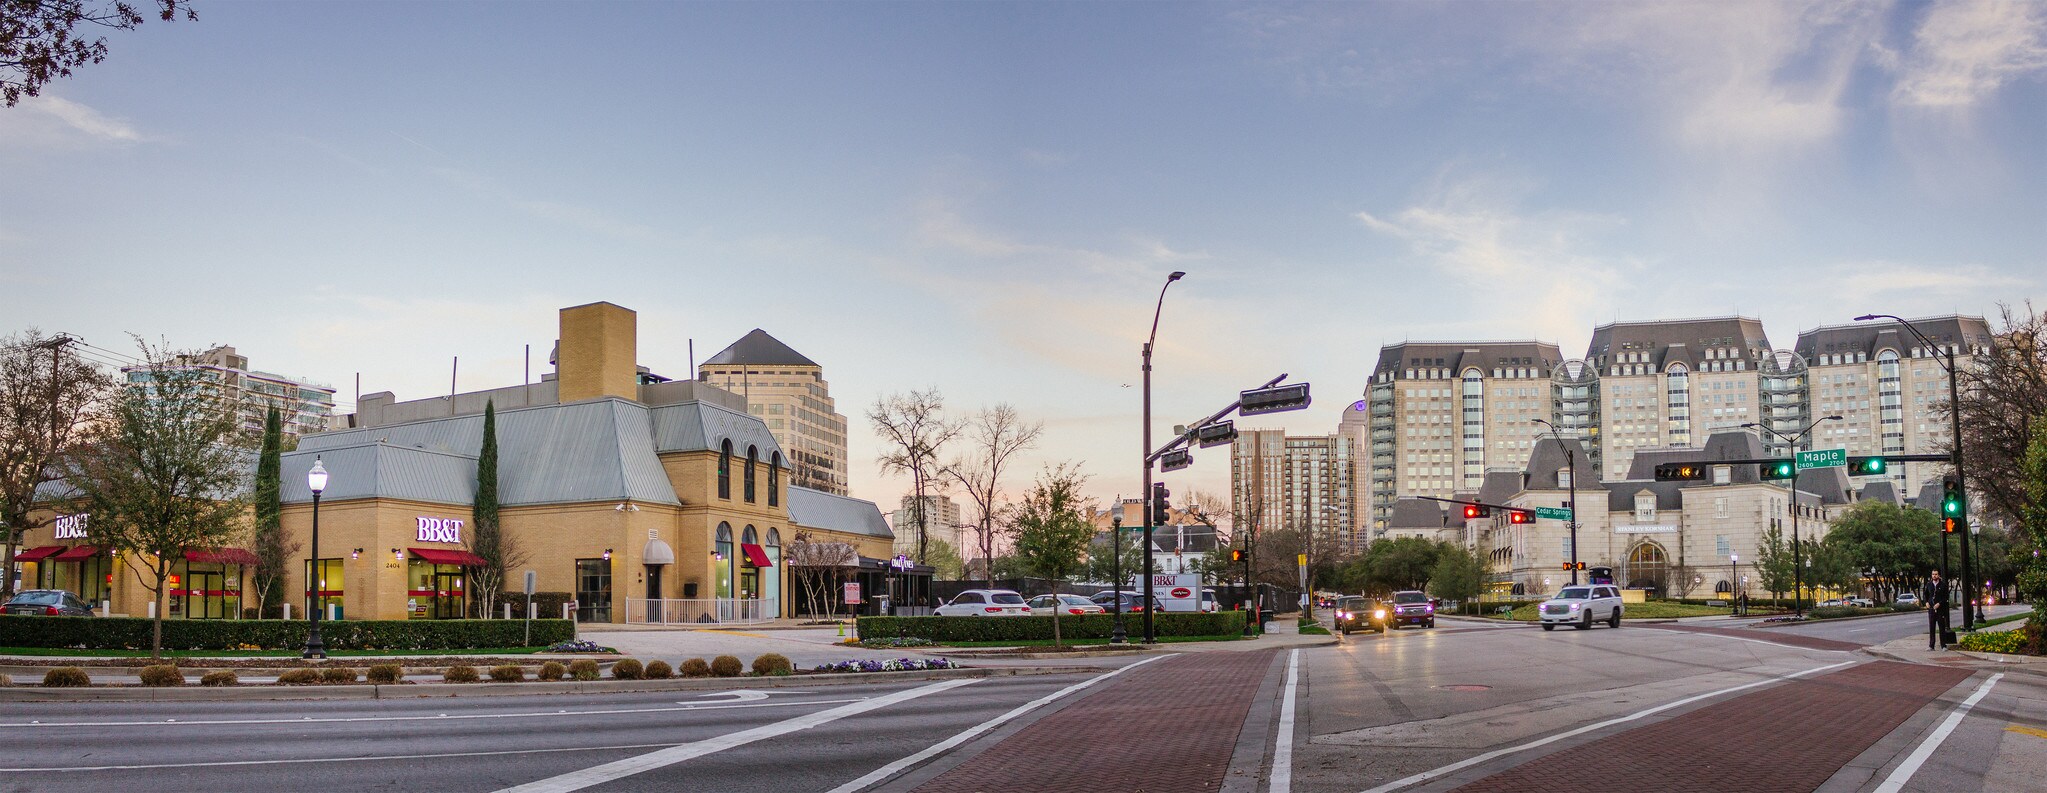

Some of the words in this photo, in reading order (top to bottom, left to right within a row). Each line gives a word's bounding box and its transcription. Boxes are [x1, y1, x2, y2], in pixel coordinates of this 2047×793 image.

[1804, 451, 1838, 463] Maple
[1536, 507, 1551, 515] Cedar
[1553, 509, 1571, 518] Springs
[416, 517, 464, 543] BB&T
[1153, 575, 1177, 586] BB&T
